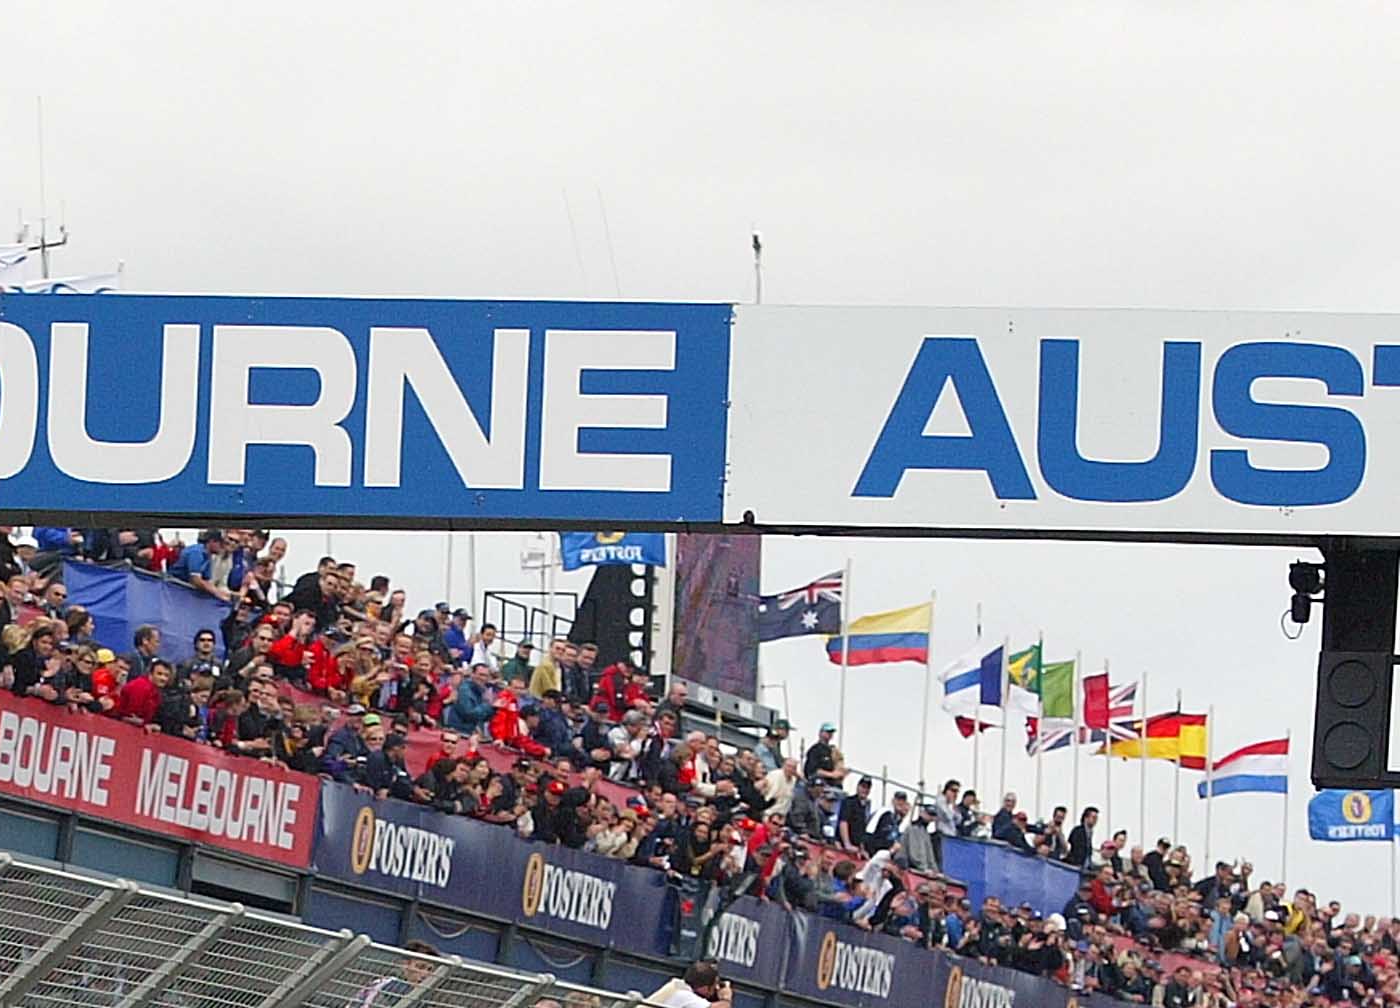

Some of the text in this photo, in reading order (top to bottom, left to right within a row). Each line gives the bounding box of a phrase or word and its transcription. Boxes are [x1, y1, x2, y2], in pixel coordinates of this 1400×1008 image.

[850, 335, 1400, 507] AUS
[135, 748, 301, 850] MELBOURNE
[368, 819, 454, 888] FOSTER'S
[538, 863, 617, 931] FOSTER'S
[830, 936, 896, 999] FOSTER'S
